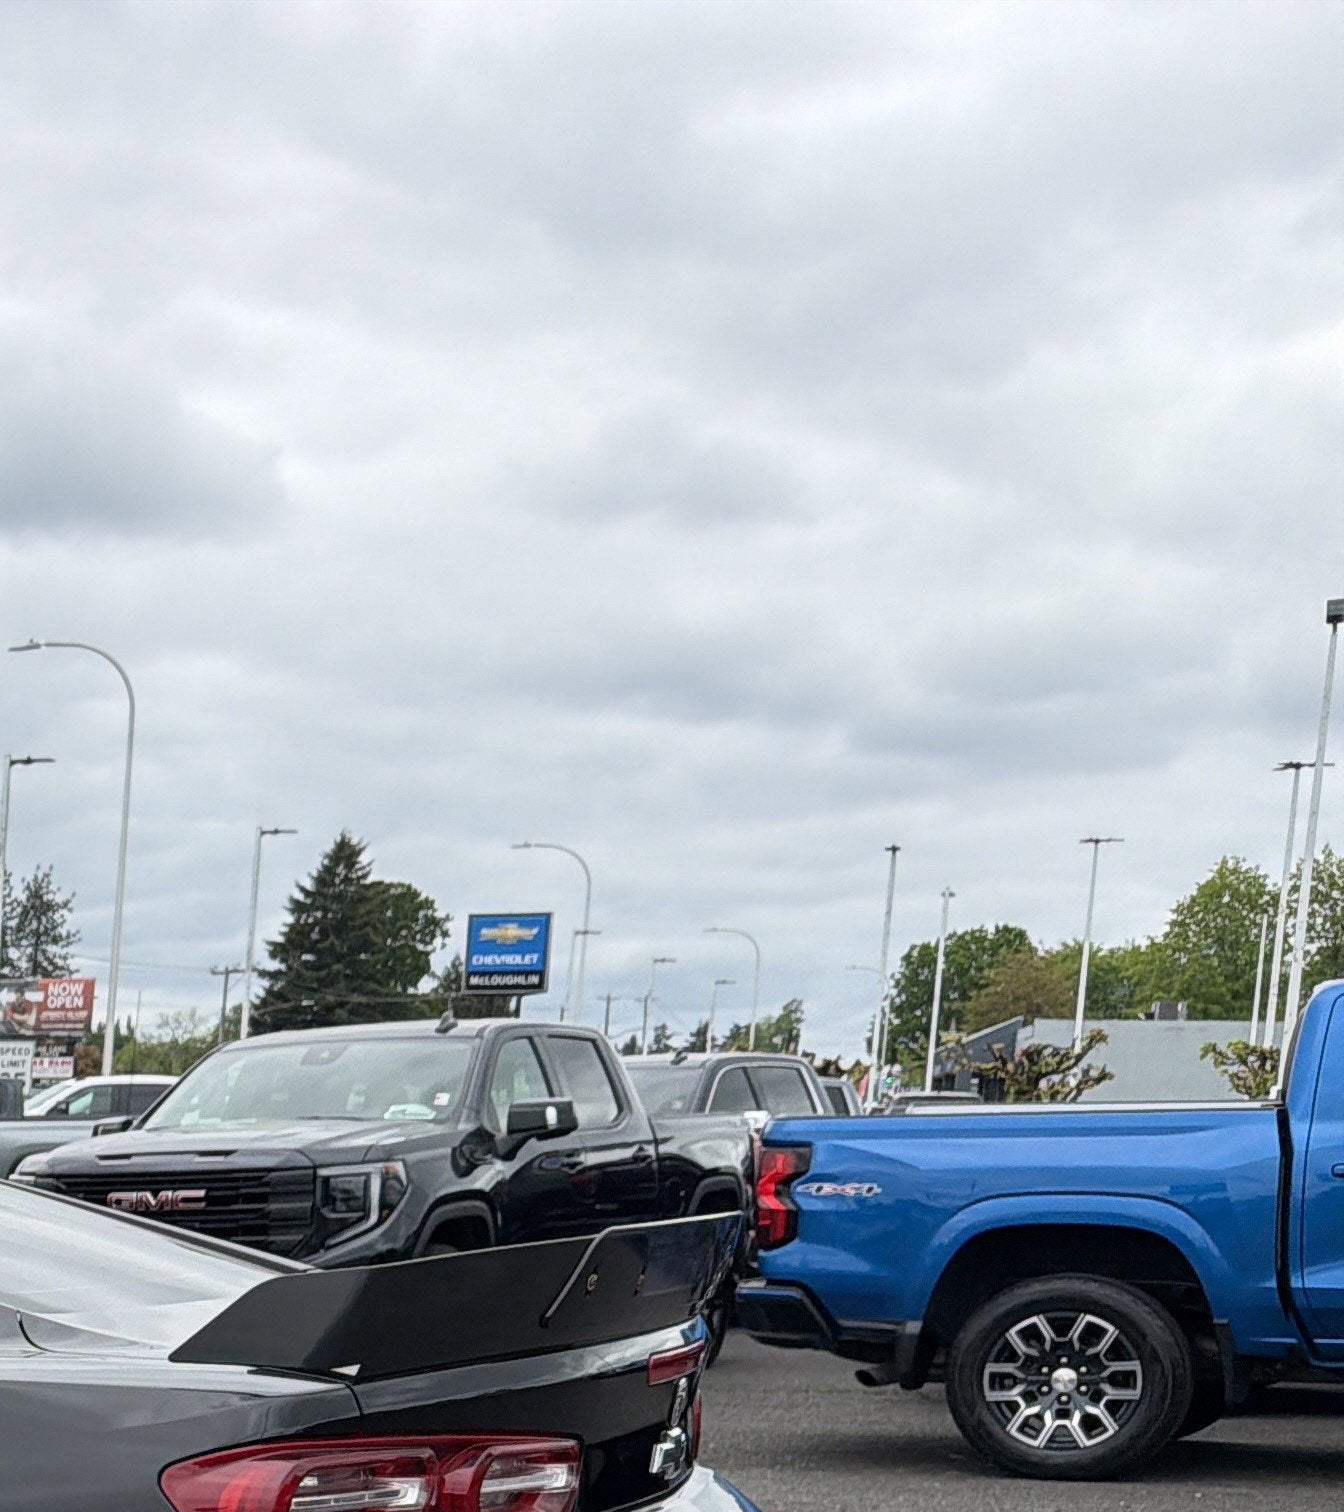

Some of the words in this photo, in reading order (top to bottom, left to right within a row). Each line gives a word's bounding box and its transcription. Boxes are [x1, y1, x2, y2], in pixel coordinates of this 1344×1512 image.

[472, 953, 539, 965] CHEVROLET
[47, 982, 84, 997] NOW
[47, 996, 84, 1009] OPEN
[0, 1046, 31, 1057] SPEED
[0, 1059, 27, 1069] LIMIT
[106, 1189, 207, 1212] GMC
